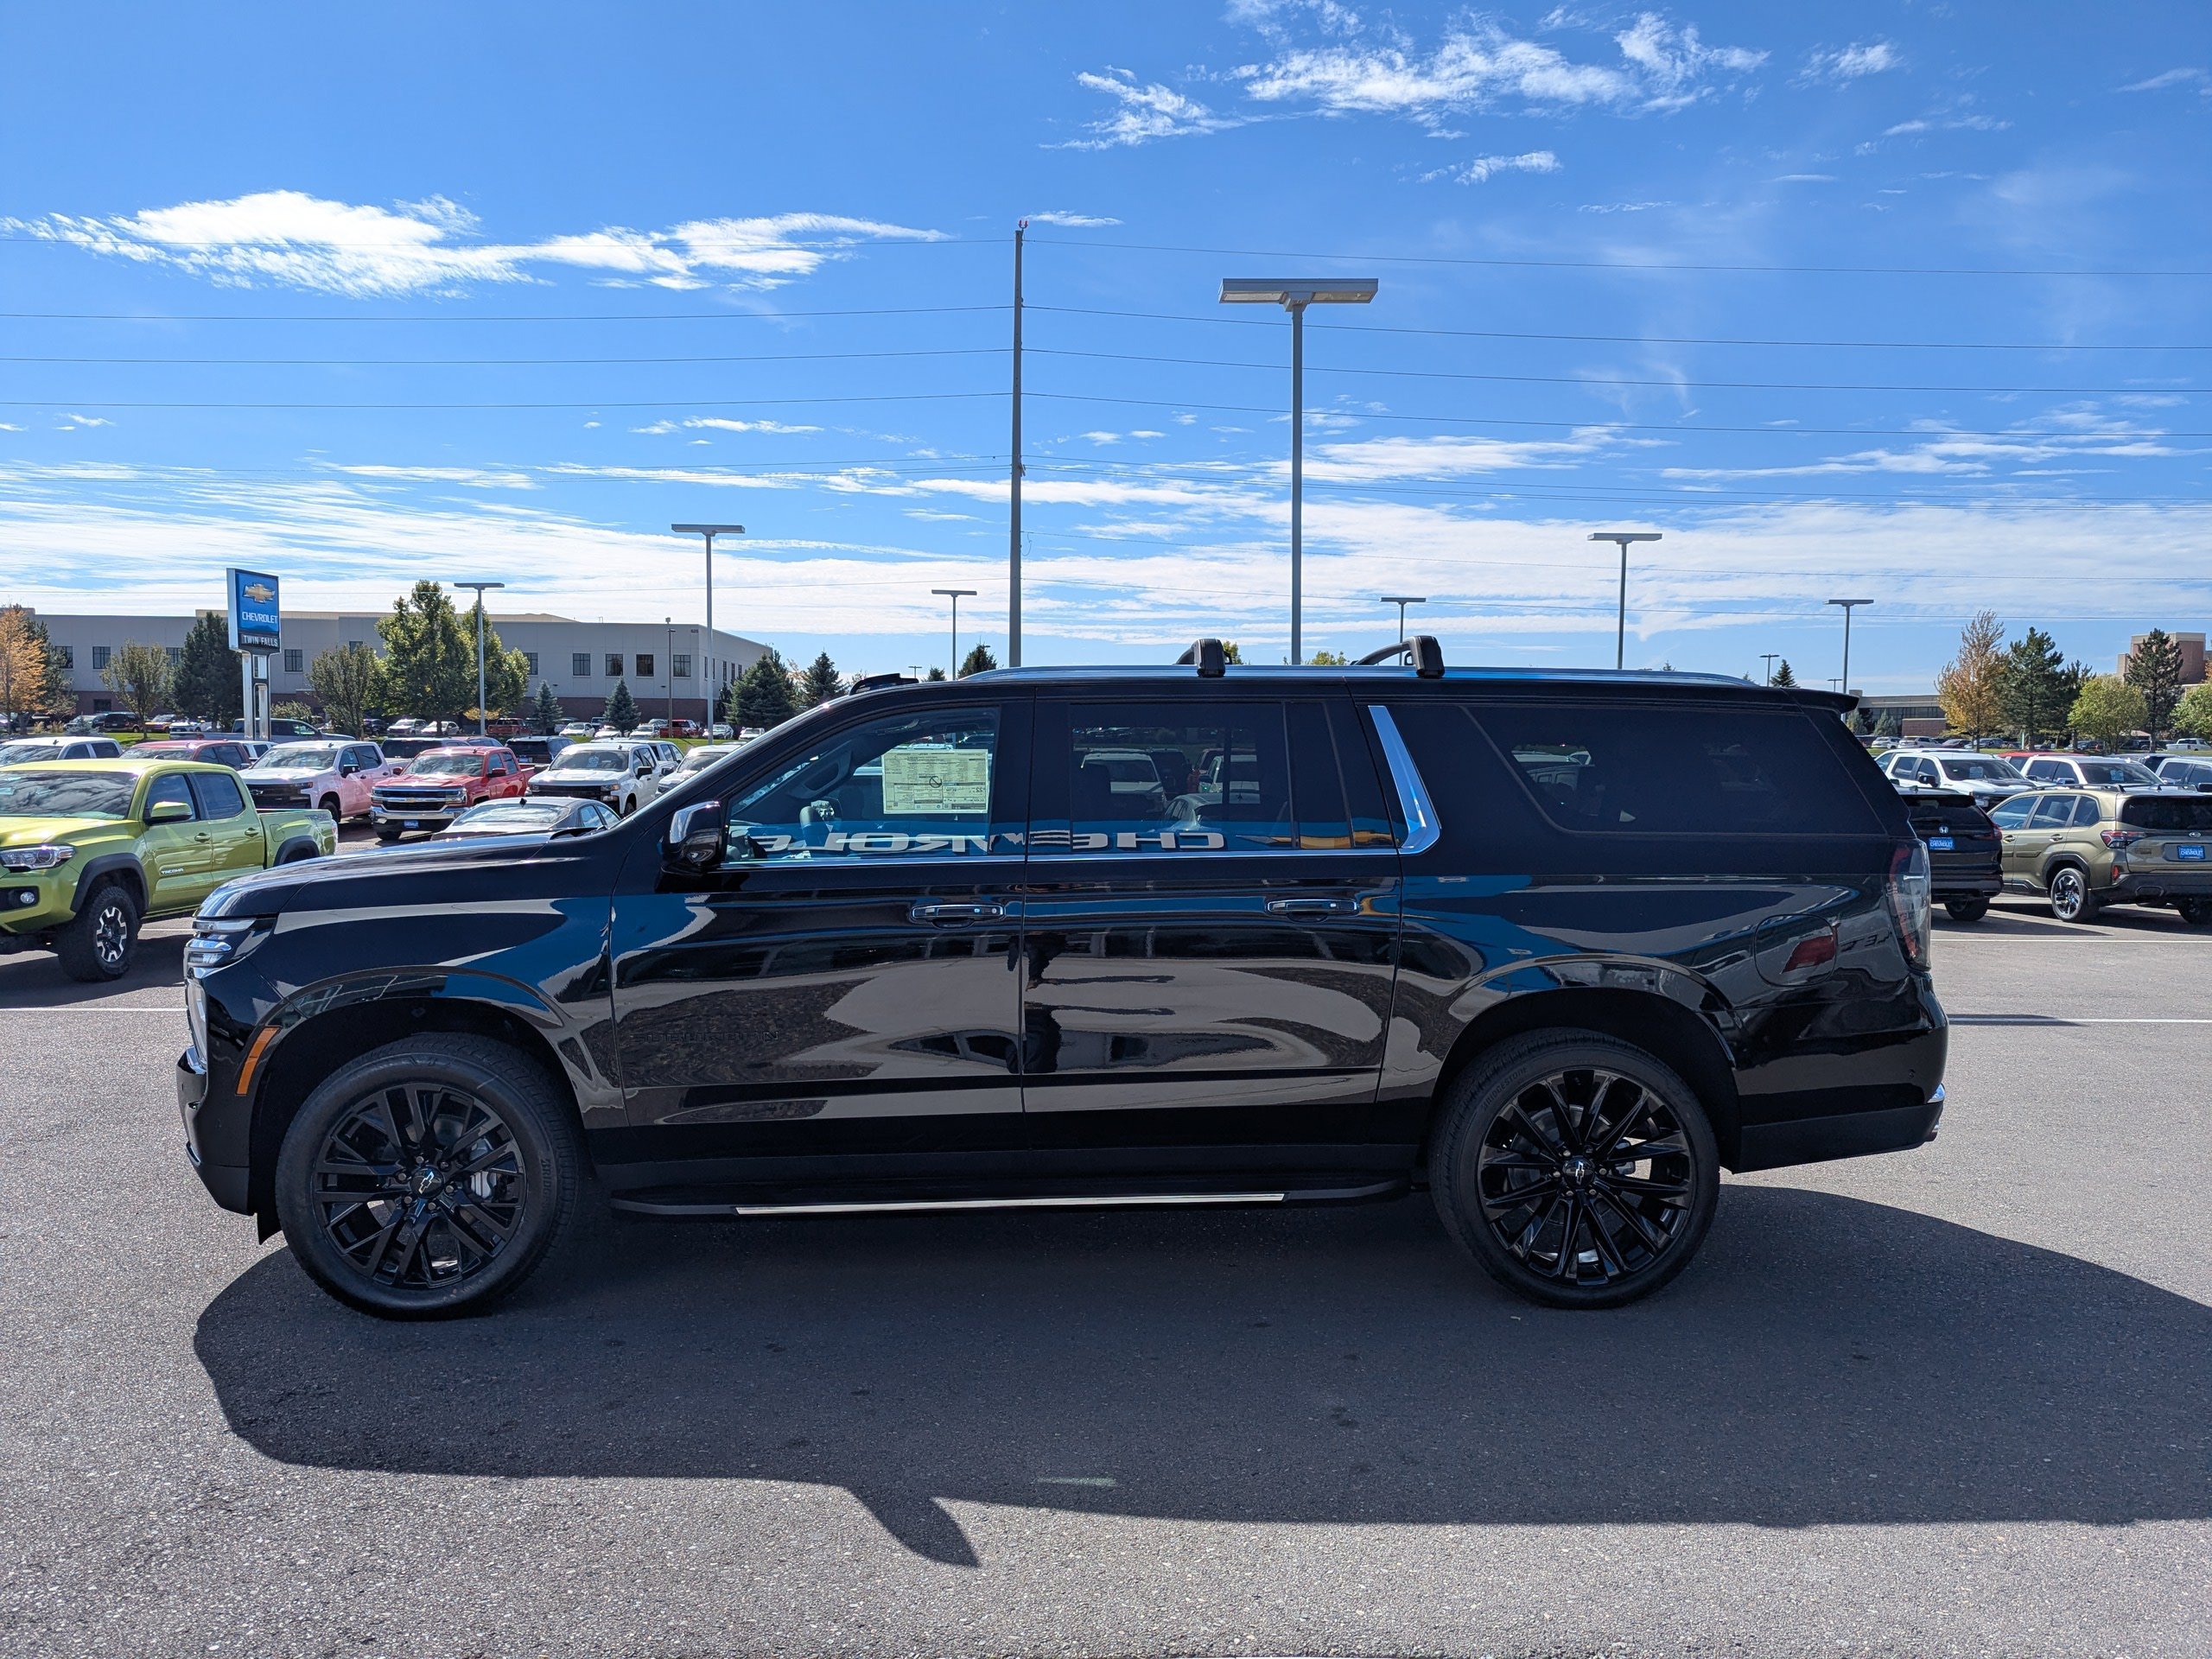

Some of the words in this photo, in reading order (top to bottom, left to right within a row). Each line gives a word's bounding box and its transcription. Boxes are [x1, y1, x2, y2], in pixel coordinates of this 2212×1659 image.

[242, 611, 278, 624] CHEVROLET
[243, 635, 259, 645] TWIN
[261, 637, 278, 646] FALLS
[629, 1030, 779, 1044] SUBURBAN
